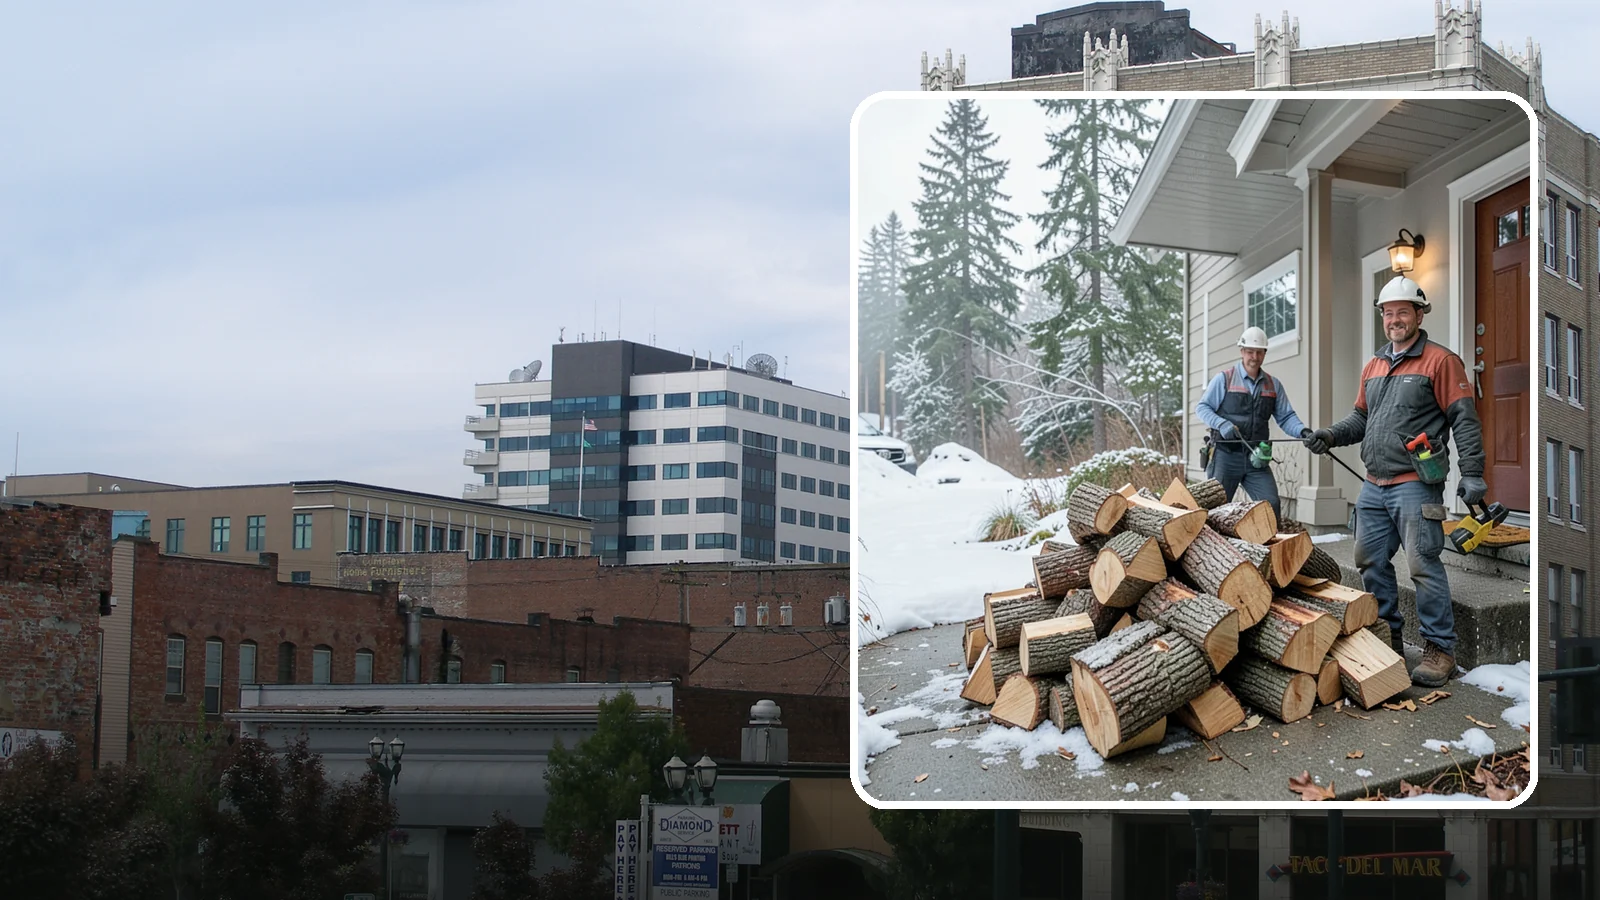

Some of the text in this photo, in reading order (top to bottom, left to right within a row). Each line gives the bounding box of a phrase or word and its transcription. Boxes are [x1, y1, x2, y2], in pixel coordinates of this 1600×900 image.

[343, 566, 427, 577] Home Furnishers
[660, 818, 713, 833] DIAMOND
[1021, 815, 1070, 827] BUILDING
[656, 845, 716, 854] RESERVED PARKING
[722, 851, 739, 861] Soup
[671, 862, 701, 870] PATRONS
[1346, 856, 1385, 875] DEL
[1392, 857, 1442, 876] MAR
[661, 889, 710, 898] PUBLIC PARKING
